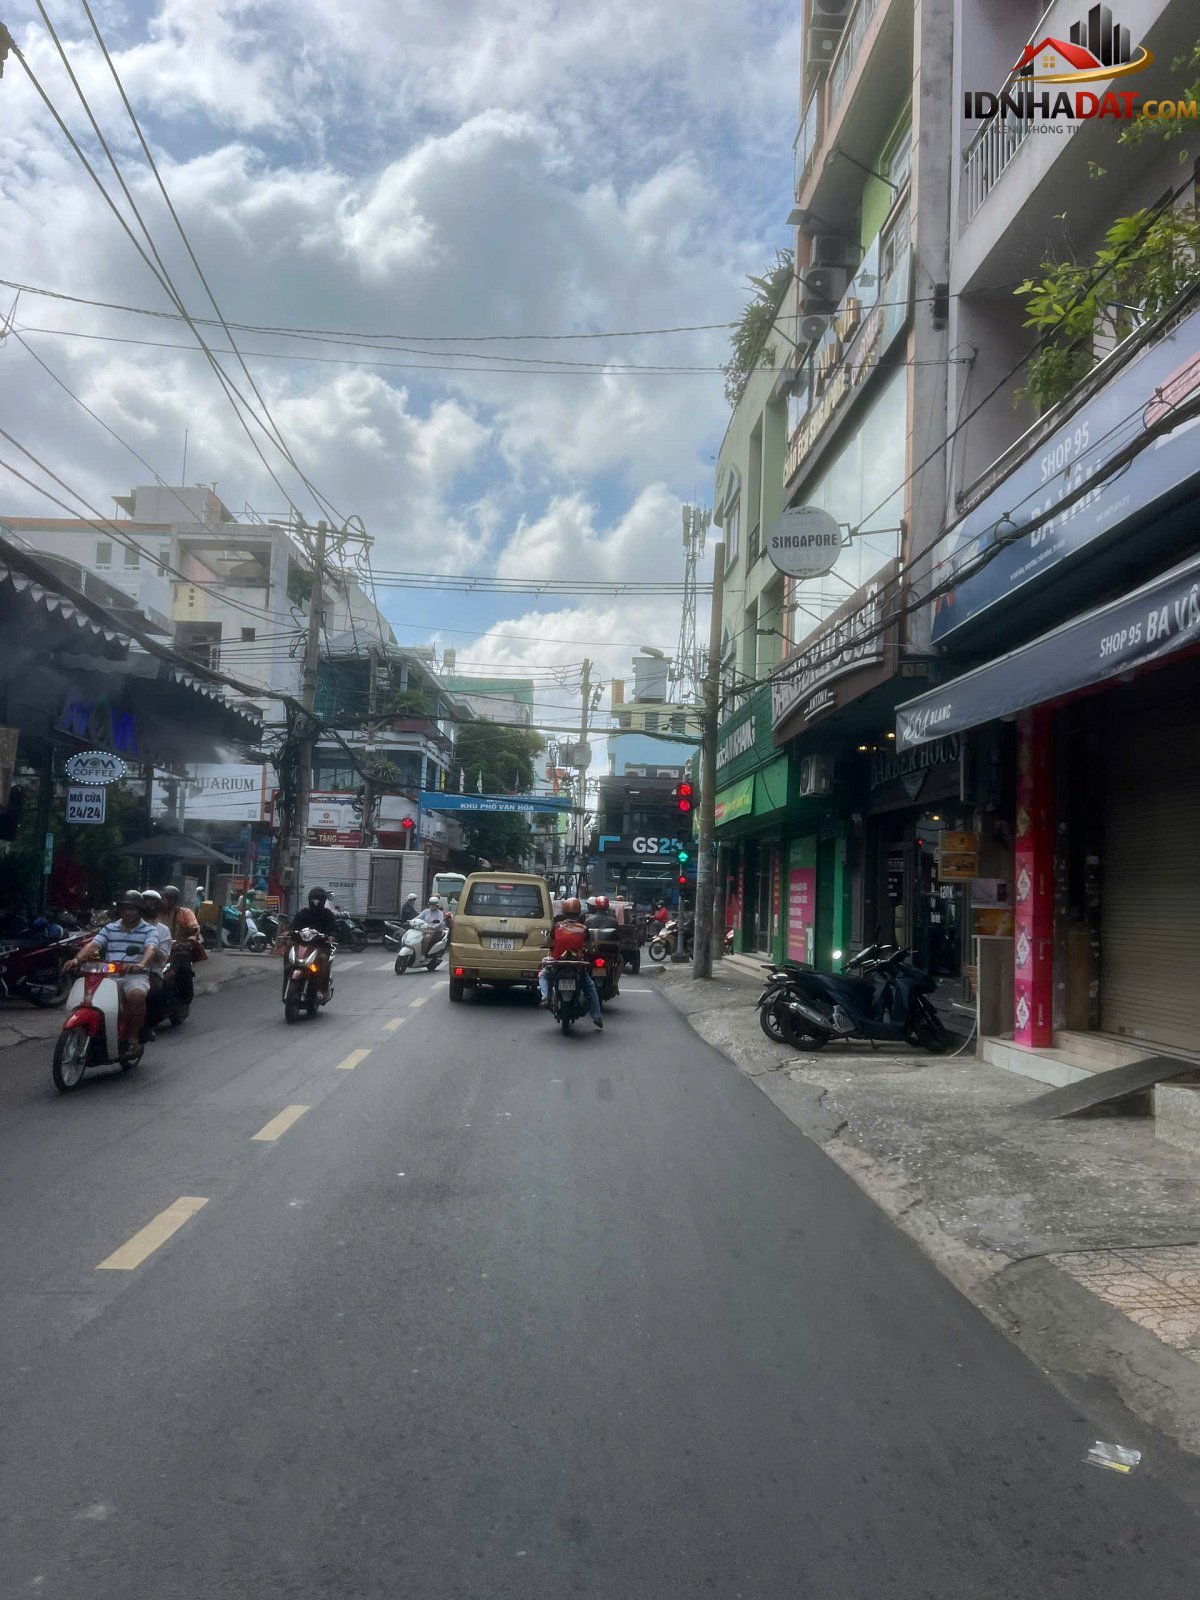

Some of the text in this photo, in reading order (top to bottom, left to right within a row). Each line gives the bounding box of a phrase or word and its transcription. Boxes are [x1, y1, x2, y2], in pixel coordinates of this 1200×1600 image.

[1040, 421, 1089, 482] SHOP 95
[772, 533, 838, 549] SINGAPORE
[1099, 629, 1127, 658] SHOP
[1128, 622, 1142, 646] 95
[1146, 605, 1170, 643] BA
[73, 768, 116, 778] COFFEE
[69, 791, 102, 803] MỞ CỬA
[69, 806, 101, 819] 24/24
[480, 801, 497, 810] PHỐ
[632, 836, 684, 854] GS25
